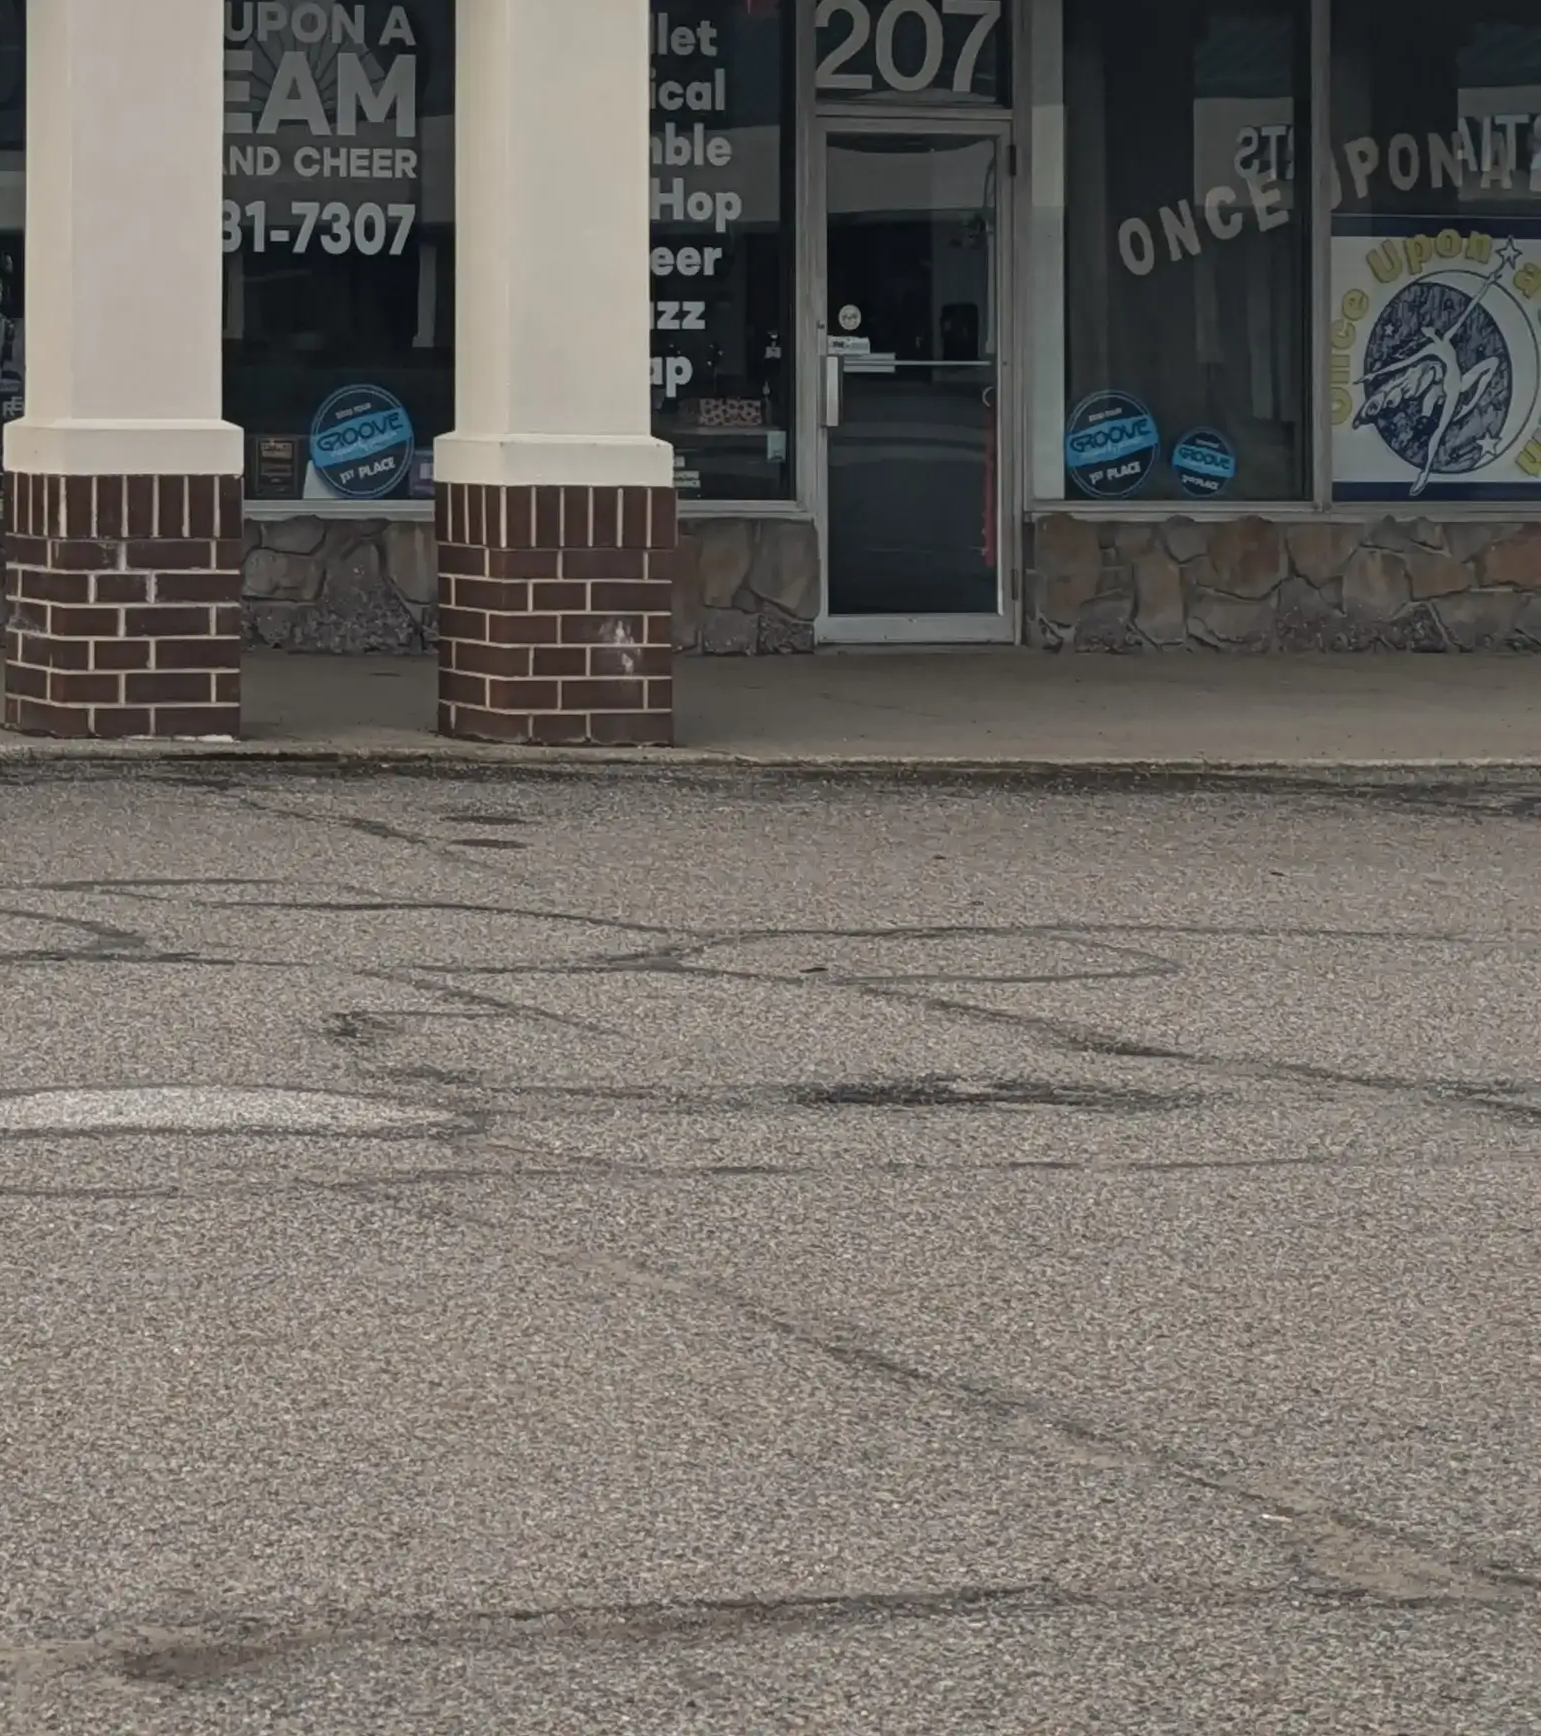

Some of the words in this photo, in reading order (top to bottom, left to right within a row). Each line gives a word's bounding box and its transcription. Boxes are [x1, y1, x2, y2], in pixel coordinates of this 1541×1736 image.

[224, 1, 365, 44] UPON
[379, 5, 416, 46] A
[224, 145, 281, 176] ND
[293, 145, 417, 179] CHEER
[650, 177, 742, 232] Hop
[1118, 168, 1290, 276] ONCE
[650, 246, 722, 276] eer
[1366, 228, 1493, 284] Upon
[317, 412, 404, 451] GROOVE
[1070, 418, 1152, 453] GROOVE
[358, 456, 396, 479] PLACE
[1107, 461, 1142, 480] PLACE
[1179, 446, 1230, 470] GROOVE
